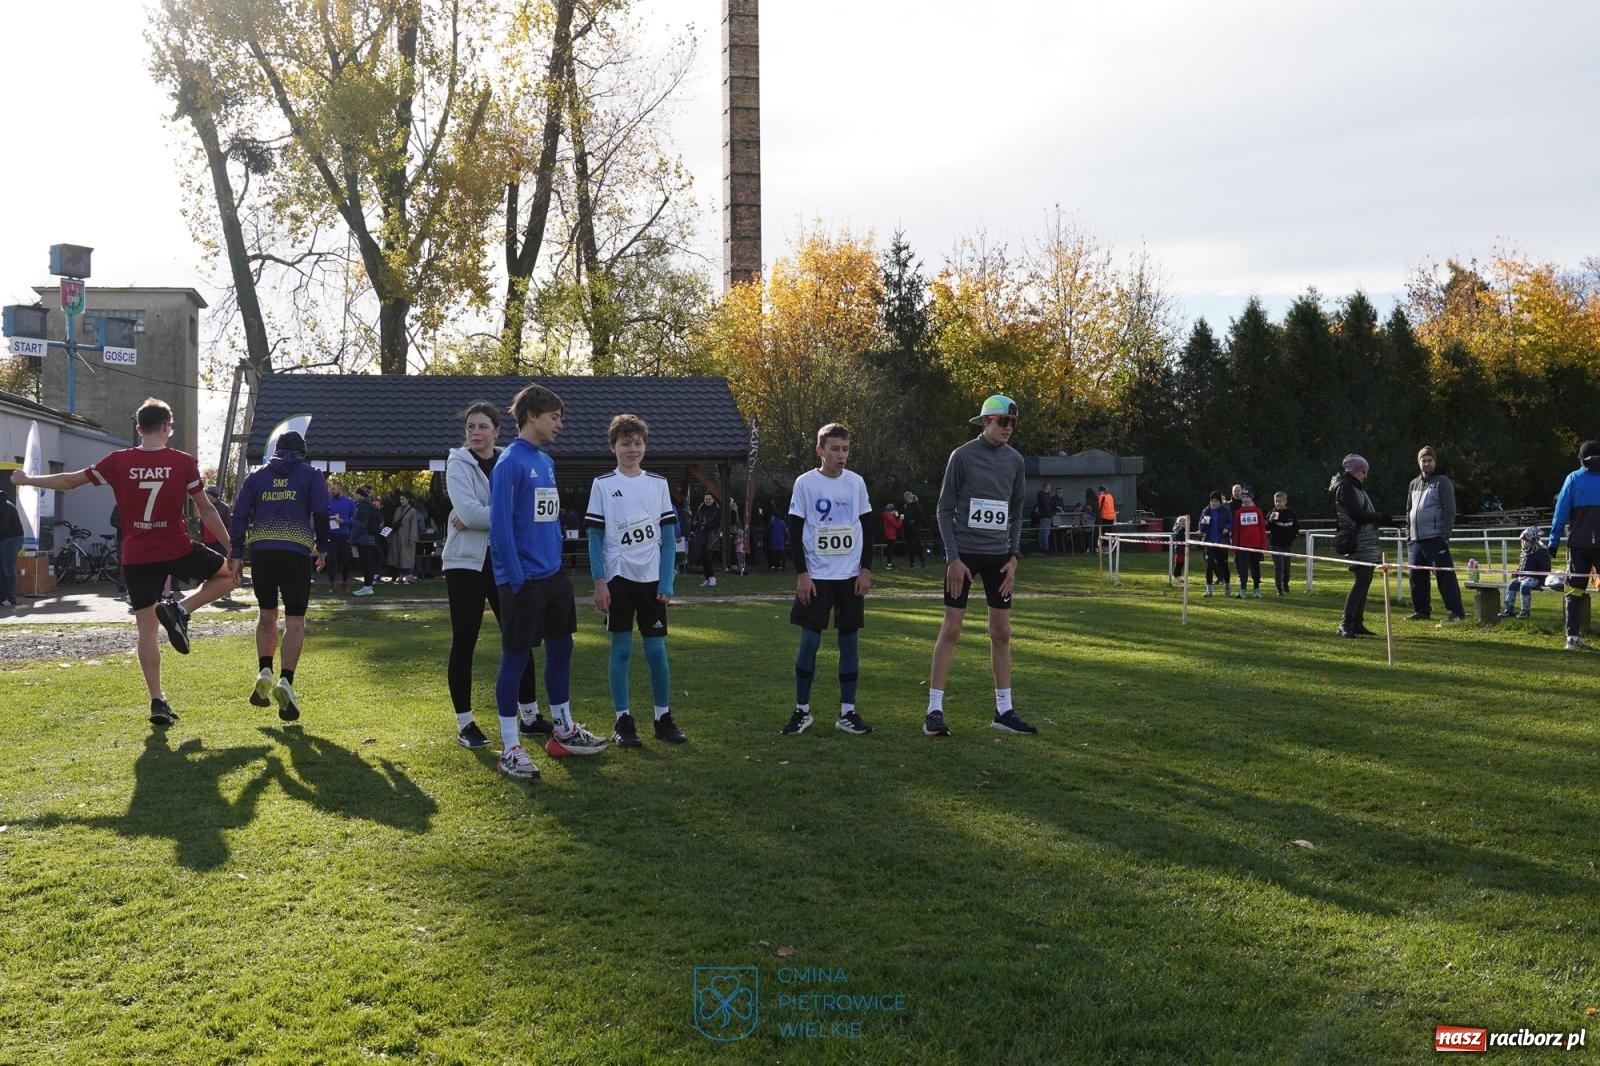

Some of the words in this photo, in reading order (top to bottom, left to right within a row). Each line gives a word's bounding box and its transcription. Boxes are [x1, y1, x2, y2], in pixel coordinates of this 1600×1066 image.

[14, 341, 43, 354] START
[105, 349, 135, 362] GOŚCIE
[128, 467, 172, 480] START
[273, 478, 289, 488] SMS
[138, 481, 164, 522] 7
[537, 500, 558, 516] 501
[971, 509, 1006, 525] 499
[621, 525, 655, 546] 498
[818, 535, 853, 550] 500
